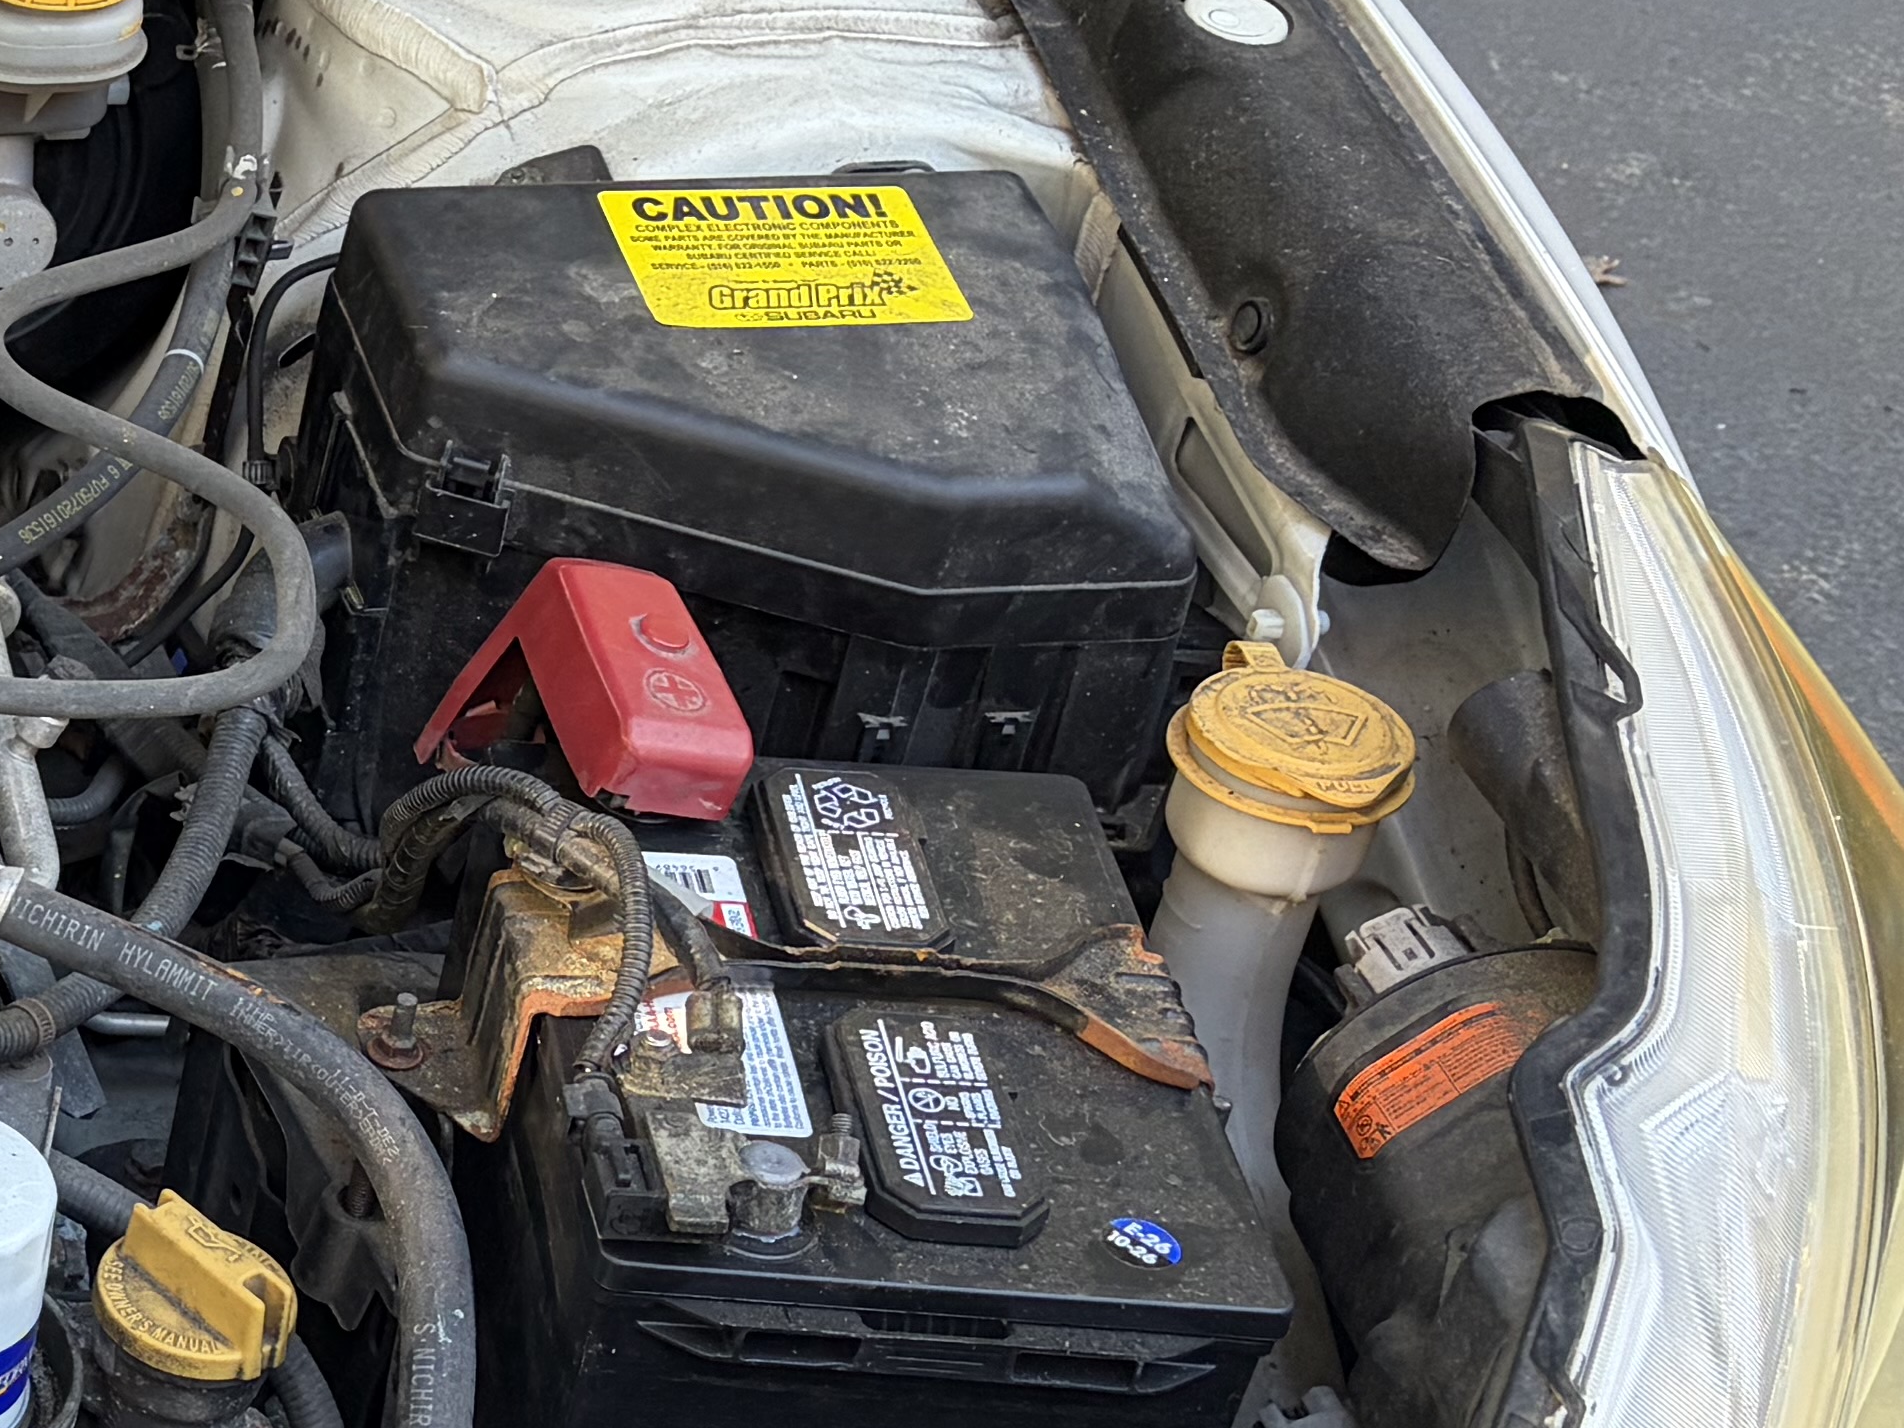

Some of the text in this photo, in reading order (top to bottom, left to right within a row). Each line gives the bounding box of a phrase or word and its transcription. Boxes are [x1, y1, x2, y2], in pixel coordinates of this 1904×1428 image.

[632, 194, 887, 222] CAUTION!
[635, 220, 899, 233] COMPLEX ELECTRONIC COMPONENTS
[664, 234, 699, 242] PARTS
[728, 233, 780, 241] COVERED
[782, 233, 797, 241] BY
[799, 232, 822, 240] THE
[825, 230, 915, 239] MANUFACTURER
[716, 243, 740, 251] FOR
[799, 241, 844, 249] SUBARU
[847, 240, 883, 248] PARTS
[886, 239, 902, 247] OR
[708, 281, 889, 310] Grand Prix
[764, 309, 877, 321] SUBARU
[119, 939, 220, 1003] HYLAMMIT
[858, 1028, 895, 1087] POISON
[881, 1103, 920, 1170] DANGER
[1107, 1230, 1158, 1265] 10-26
[1123, 1222, 1173, 1254] E-26
[103, 1260, 123, 1280] SEE
[153, 1324, 221, 1355] MANUAL
